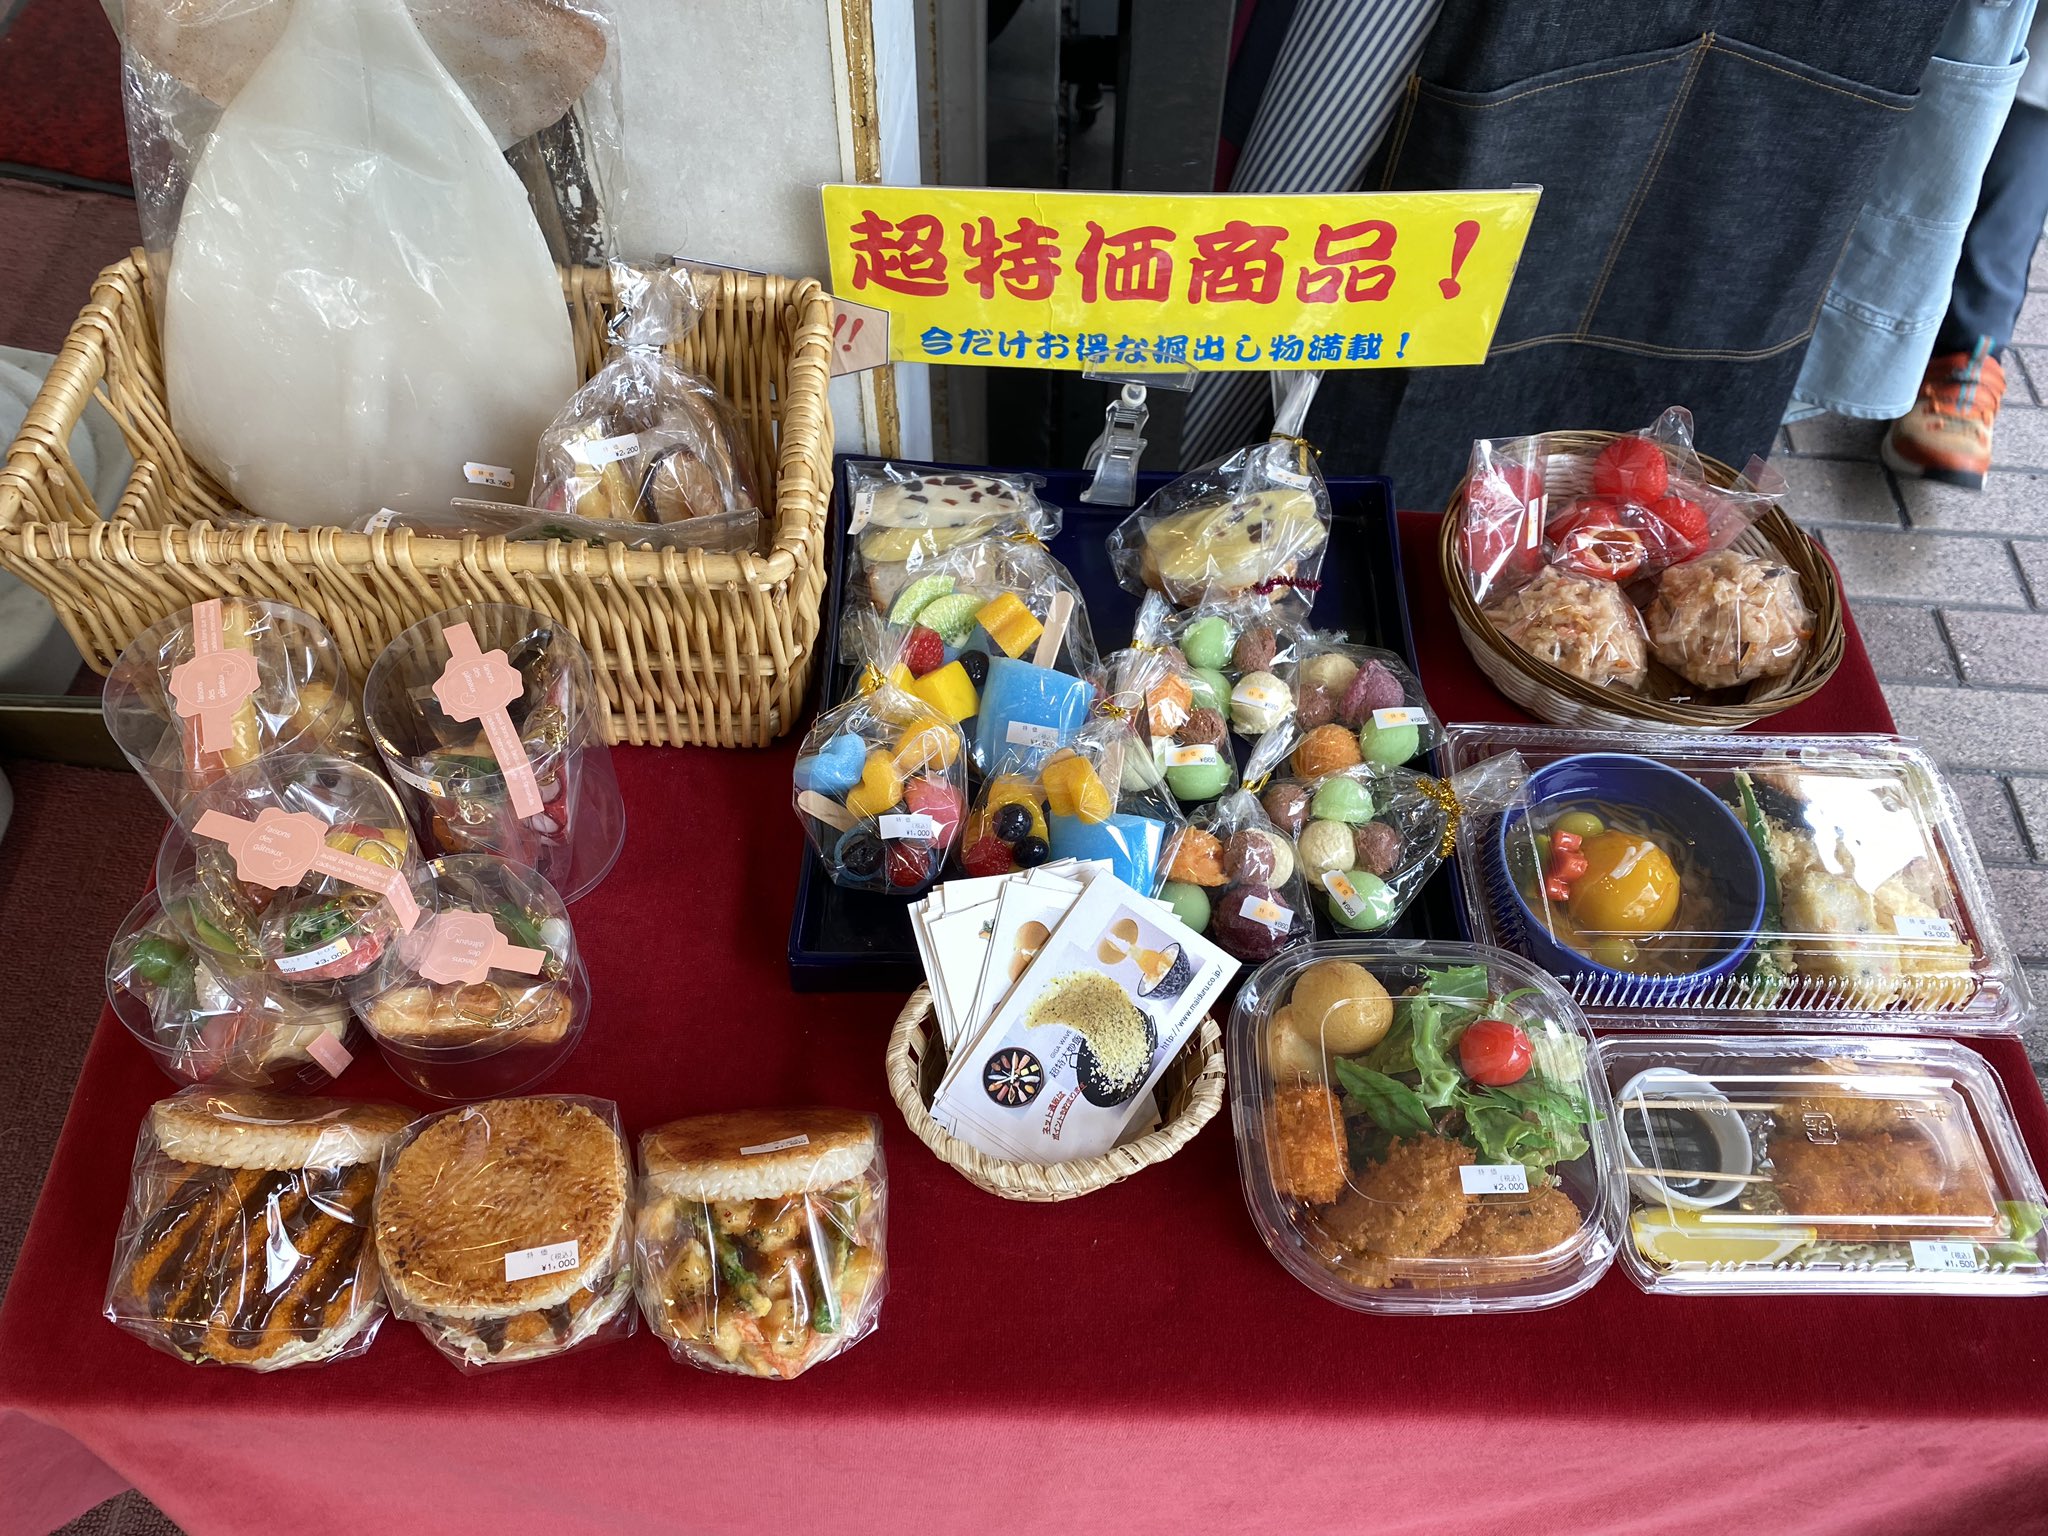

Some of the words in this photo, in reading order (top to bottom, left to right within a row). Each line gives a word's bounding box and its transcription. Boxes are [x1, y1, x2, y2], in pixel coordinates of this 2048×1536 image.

[850, 209, 1481, 305] 超特価商品！
[919, 325, 1412, 365] 今だけお得な掘出し物満載！
[1059, 1028, 1073, 1046] WAVE
[1493, 1182, 1525, 1191] ¥2,000
